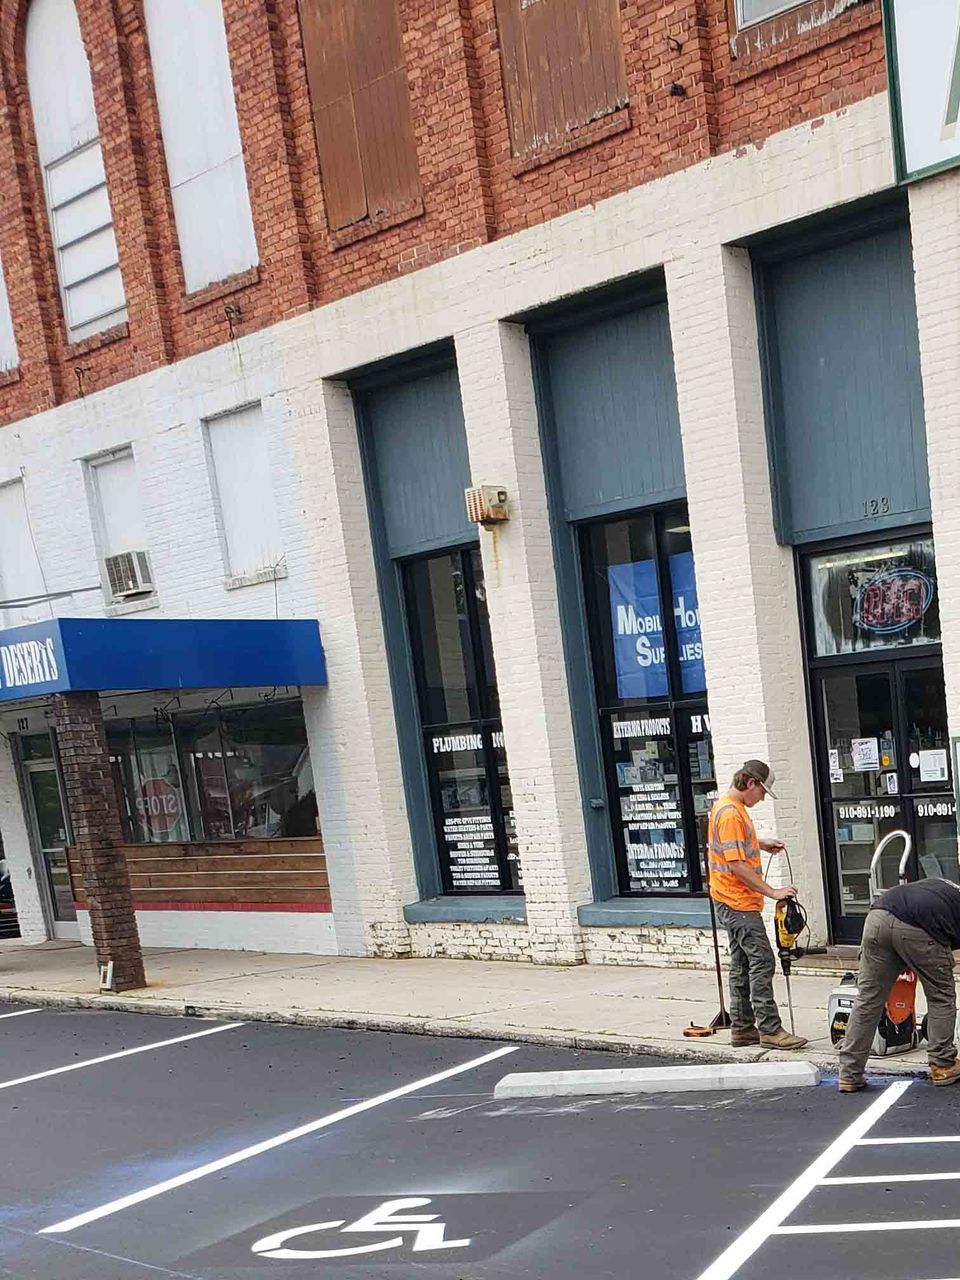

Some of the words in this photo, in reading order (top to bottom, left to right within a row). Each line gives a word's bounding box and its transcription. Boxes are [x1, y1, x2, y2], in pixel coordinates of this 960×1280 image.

[863, 497, 889, 517] 123
[617, 604, 662, 634] MOBIL
[674, 596, 701, 628] HO
[636, 635, 702, 667] SUPIES
[17, 717, 29, 731] 127
[432, 734, 483, 753] PLUMBING
